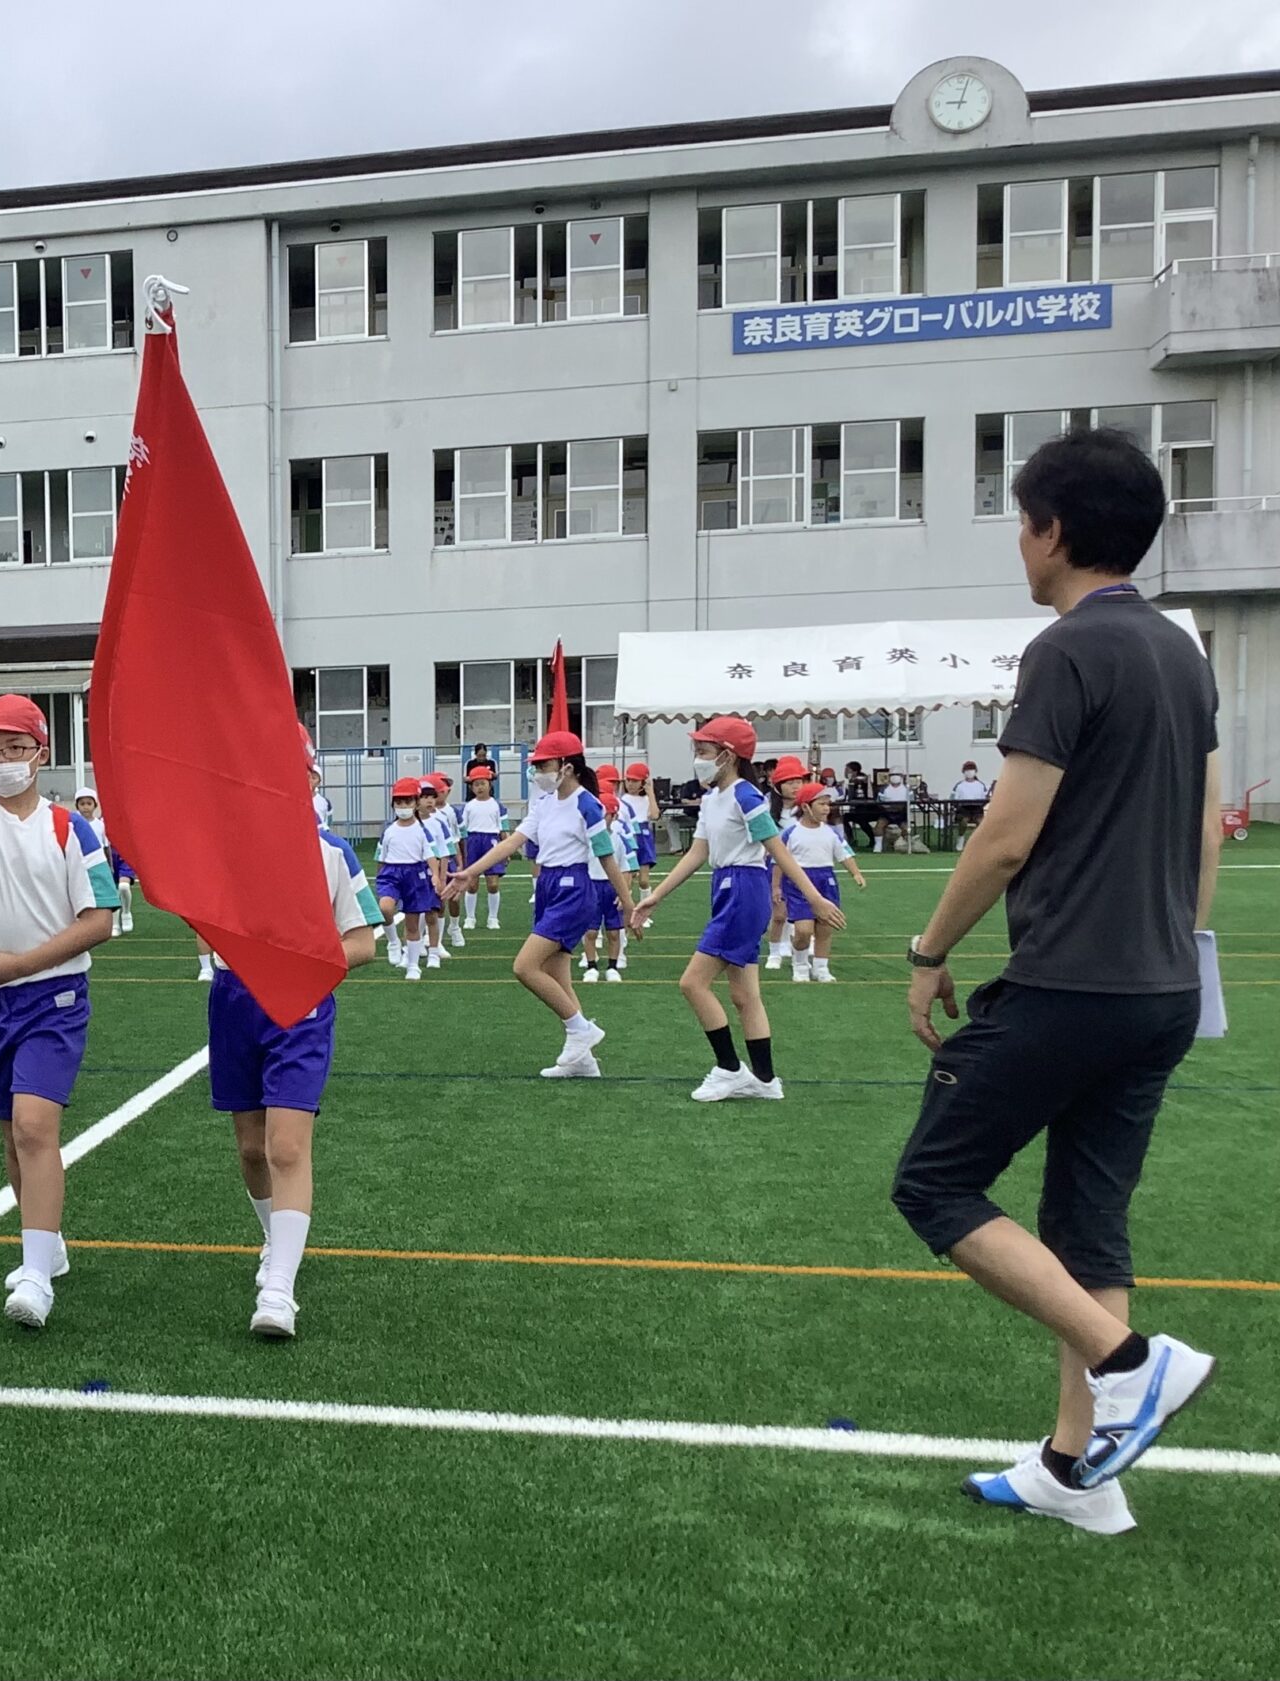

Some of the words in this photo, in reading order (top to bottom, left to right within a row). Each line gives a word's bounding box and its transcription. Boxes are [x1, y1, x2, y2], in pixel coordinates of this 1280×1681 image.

[743, 292, 1102, 346] 奈良育英グローバル小学校
